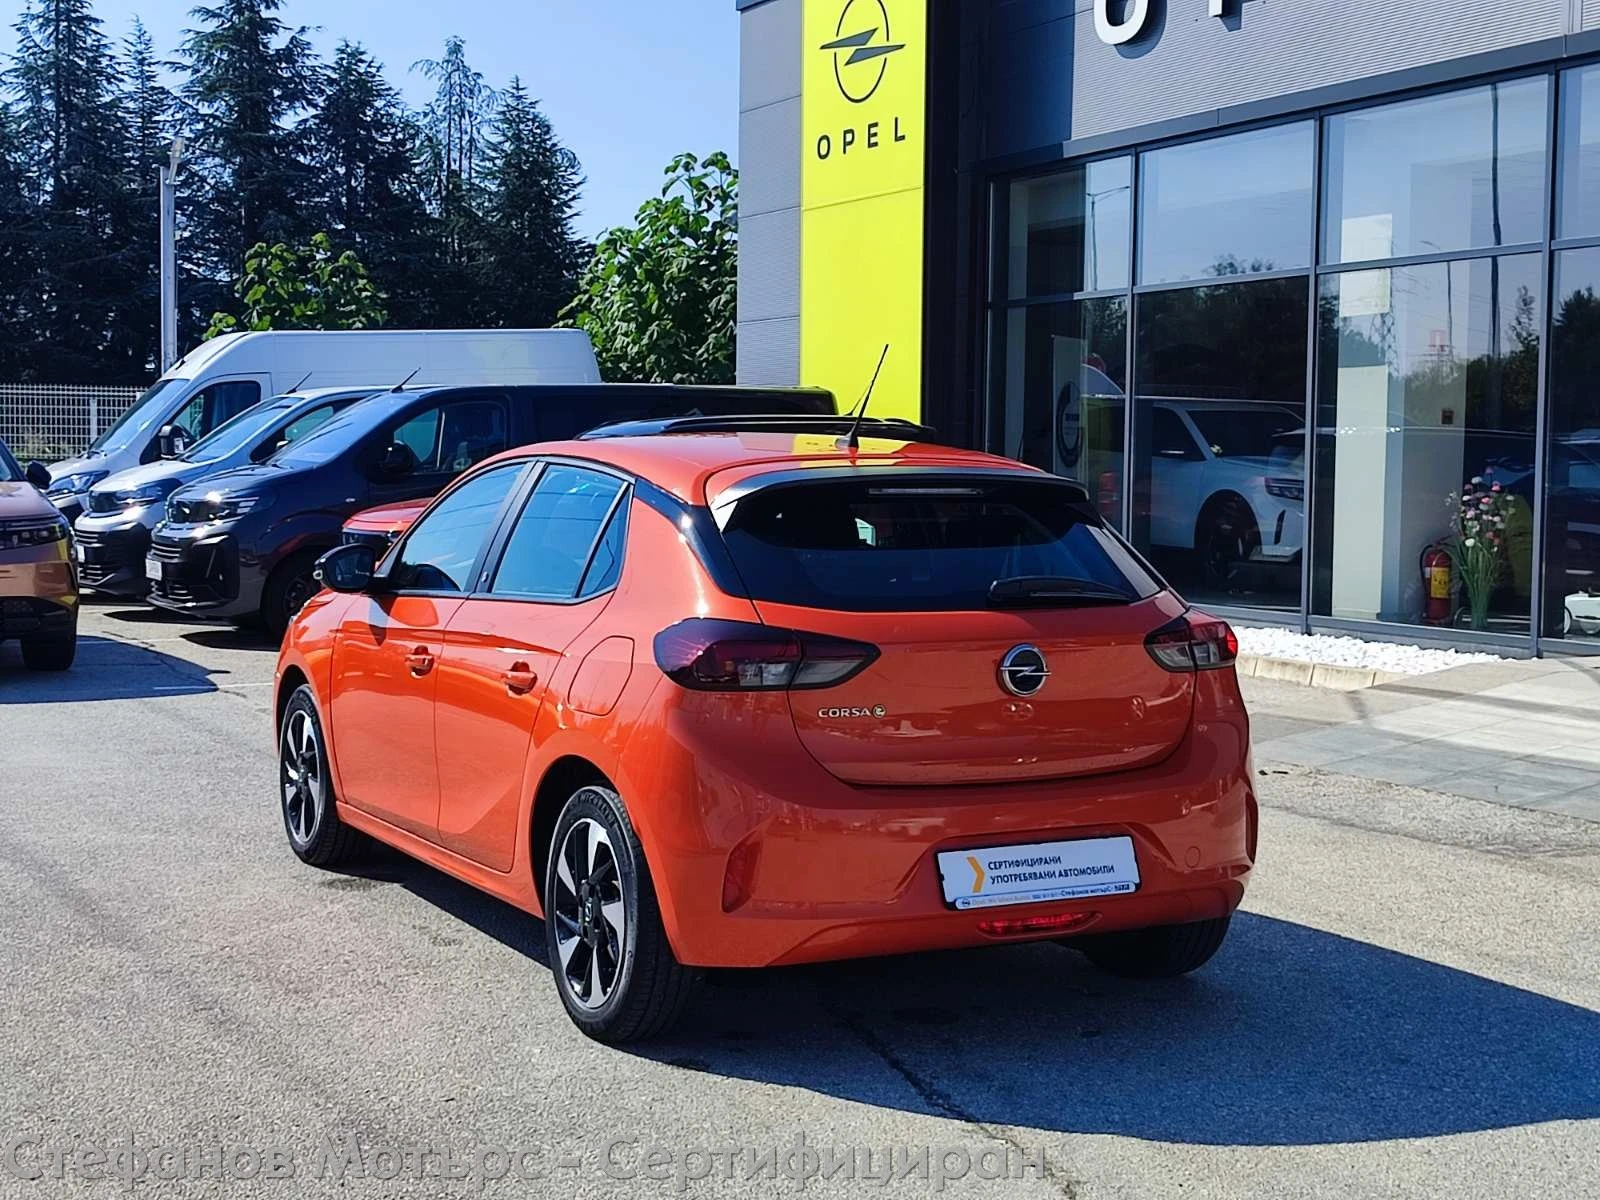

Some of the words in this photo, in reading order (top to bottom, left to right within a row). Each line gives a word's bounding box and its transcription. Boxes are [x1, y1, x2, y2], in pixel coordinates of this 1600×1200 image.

[817, 116, 906, 160] OPEL
[818, 707, 872, 718] CORSA
[987, 856, 1062, 871] СЕРТИФИЦИРАНИ
[990, 870, 1057, 885] УПОТРЕБЯВАНИ
[1058, 864, 1115, 879] АВТОМОБИЛИ
